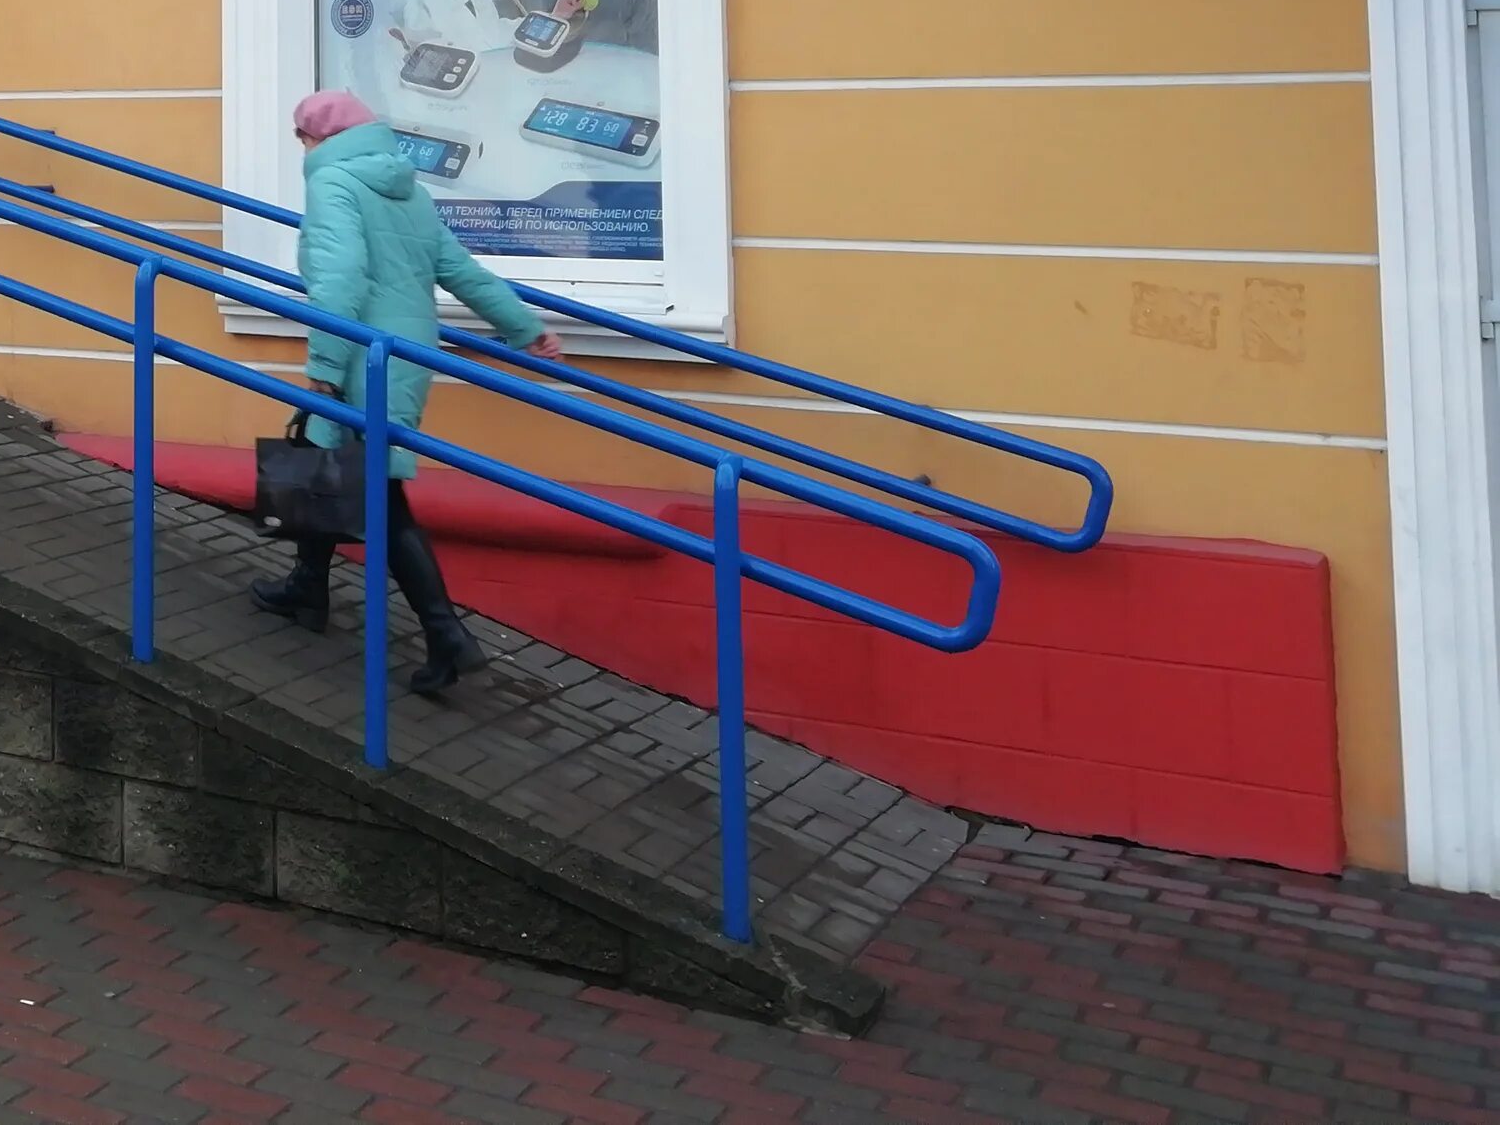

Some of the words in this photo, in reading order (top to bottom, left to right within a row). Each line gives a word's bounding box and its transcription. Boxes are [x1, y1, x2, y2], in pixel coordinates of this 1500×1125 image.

[506, 206, 543, 219] ПЕРЕД
[544, 207, 632, 220] ПРИМЕНЕНИЕМ
[447, 217, 523, 230] ИНСТРУКЦИЕЙ
[524, 218, 542, 231] ПО
[543, 220, 651, 233] ИСПОЛЬЗОВАНИЮ.
